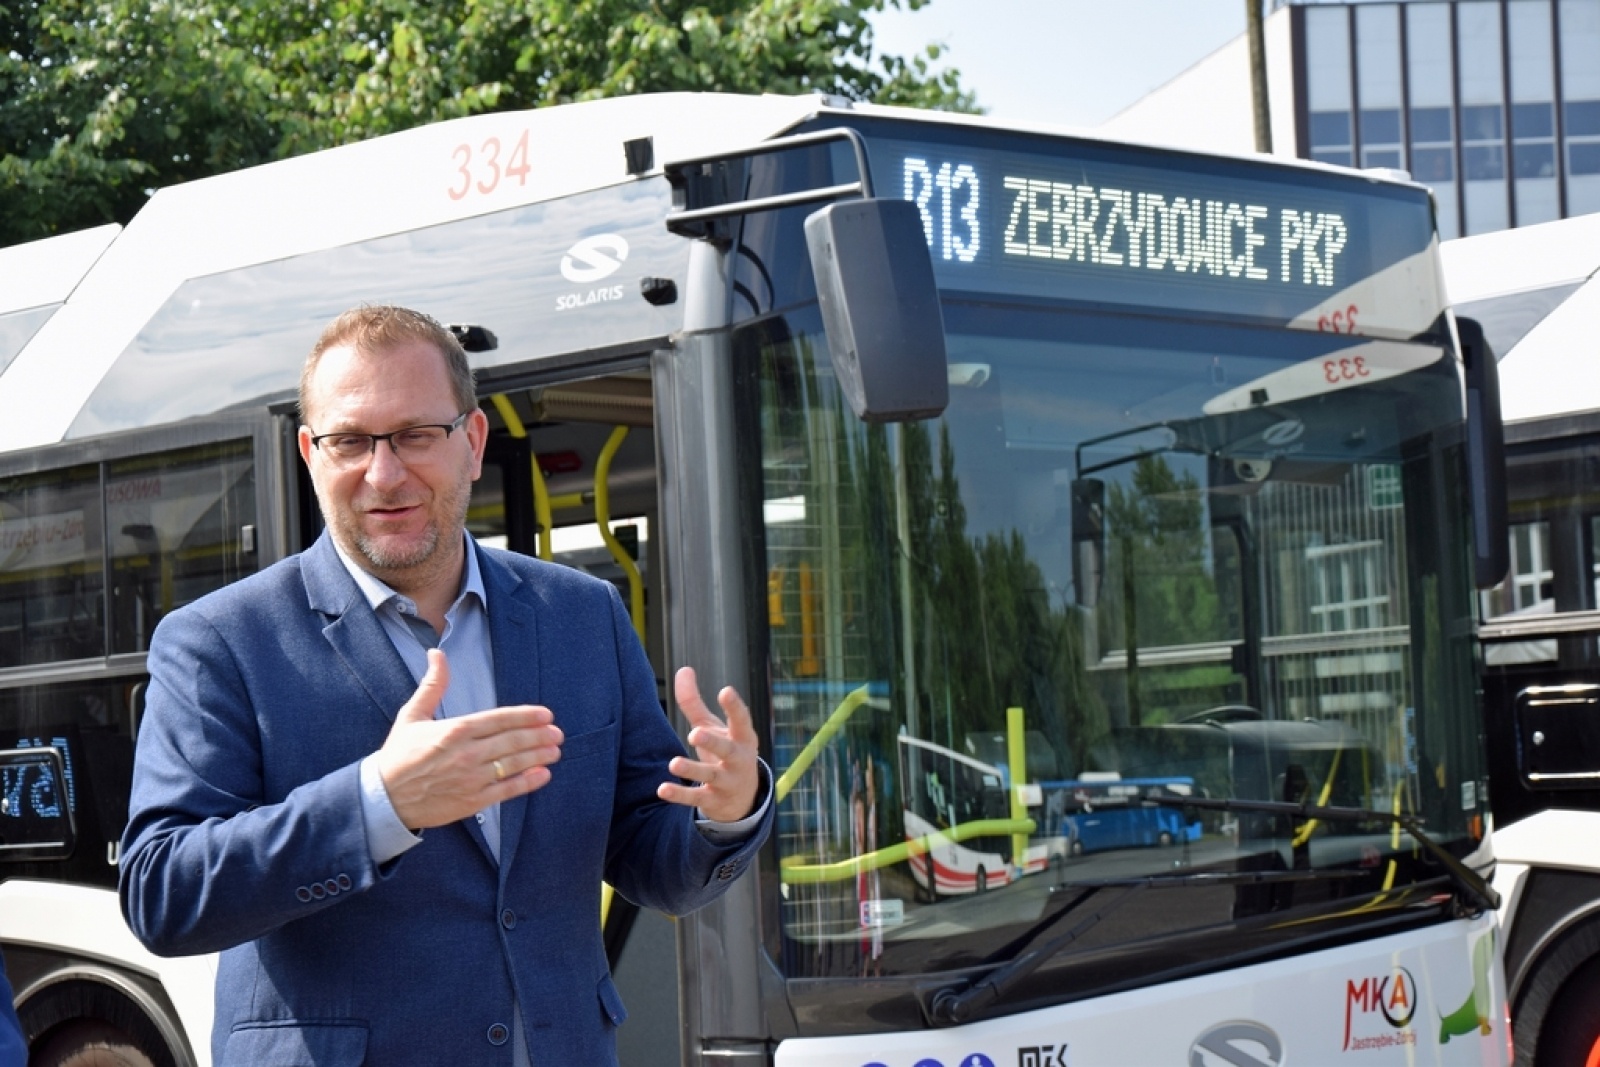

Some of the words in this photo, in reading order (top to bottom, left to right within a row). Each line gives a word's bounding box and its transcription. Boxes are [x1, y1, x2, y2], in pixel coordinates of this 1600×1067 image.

[447, 128, 531, 201] 334
[1003, 176, 1268, 281] ZEBRZYDOWICE
[1281, 207, 1348, 287] PKP
[555, 284, 624, 311] SOLARIS
